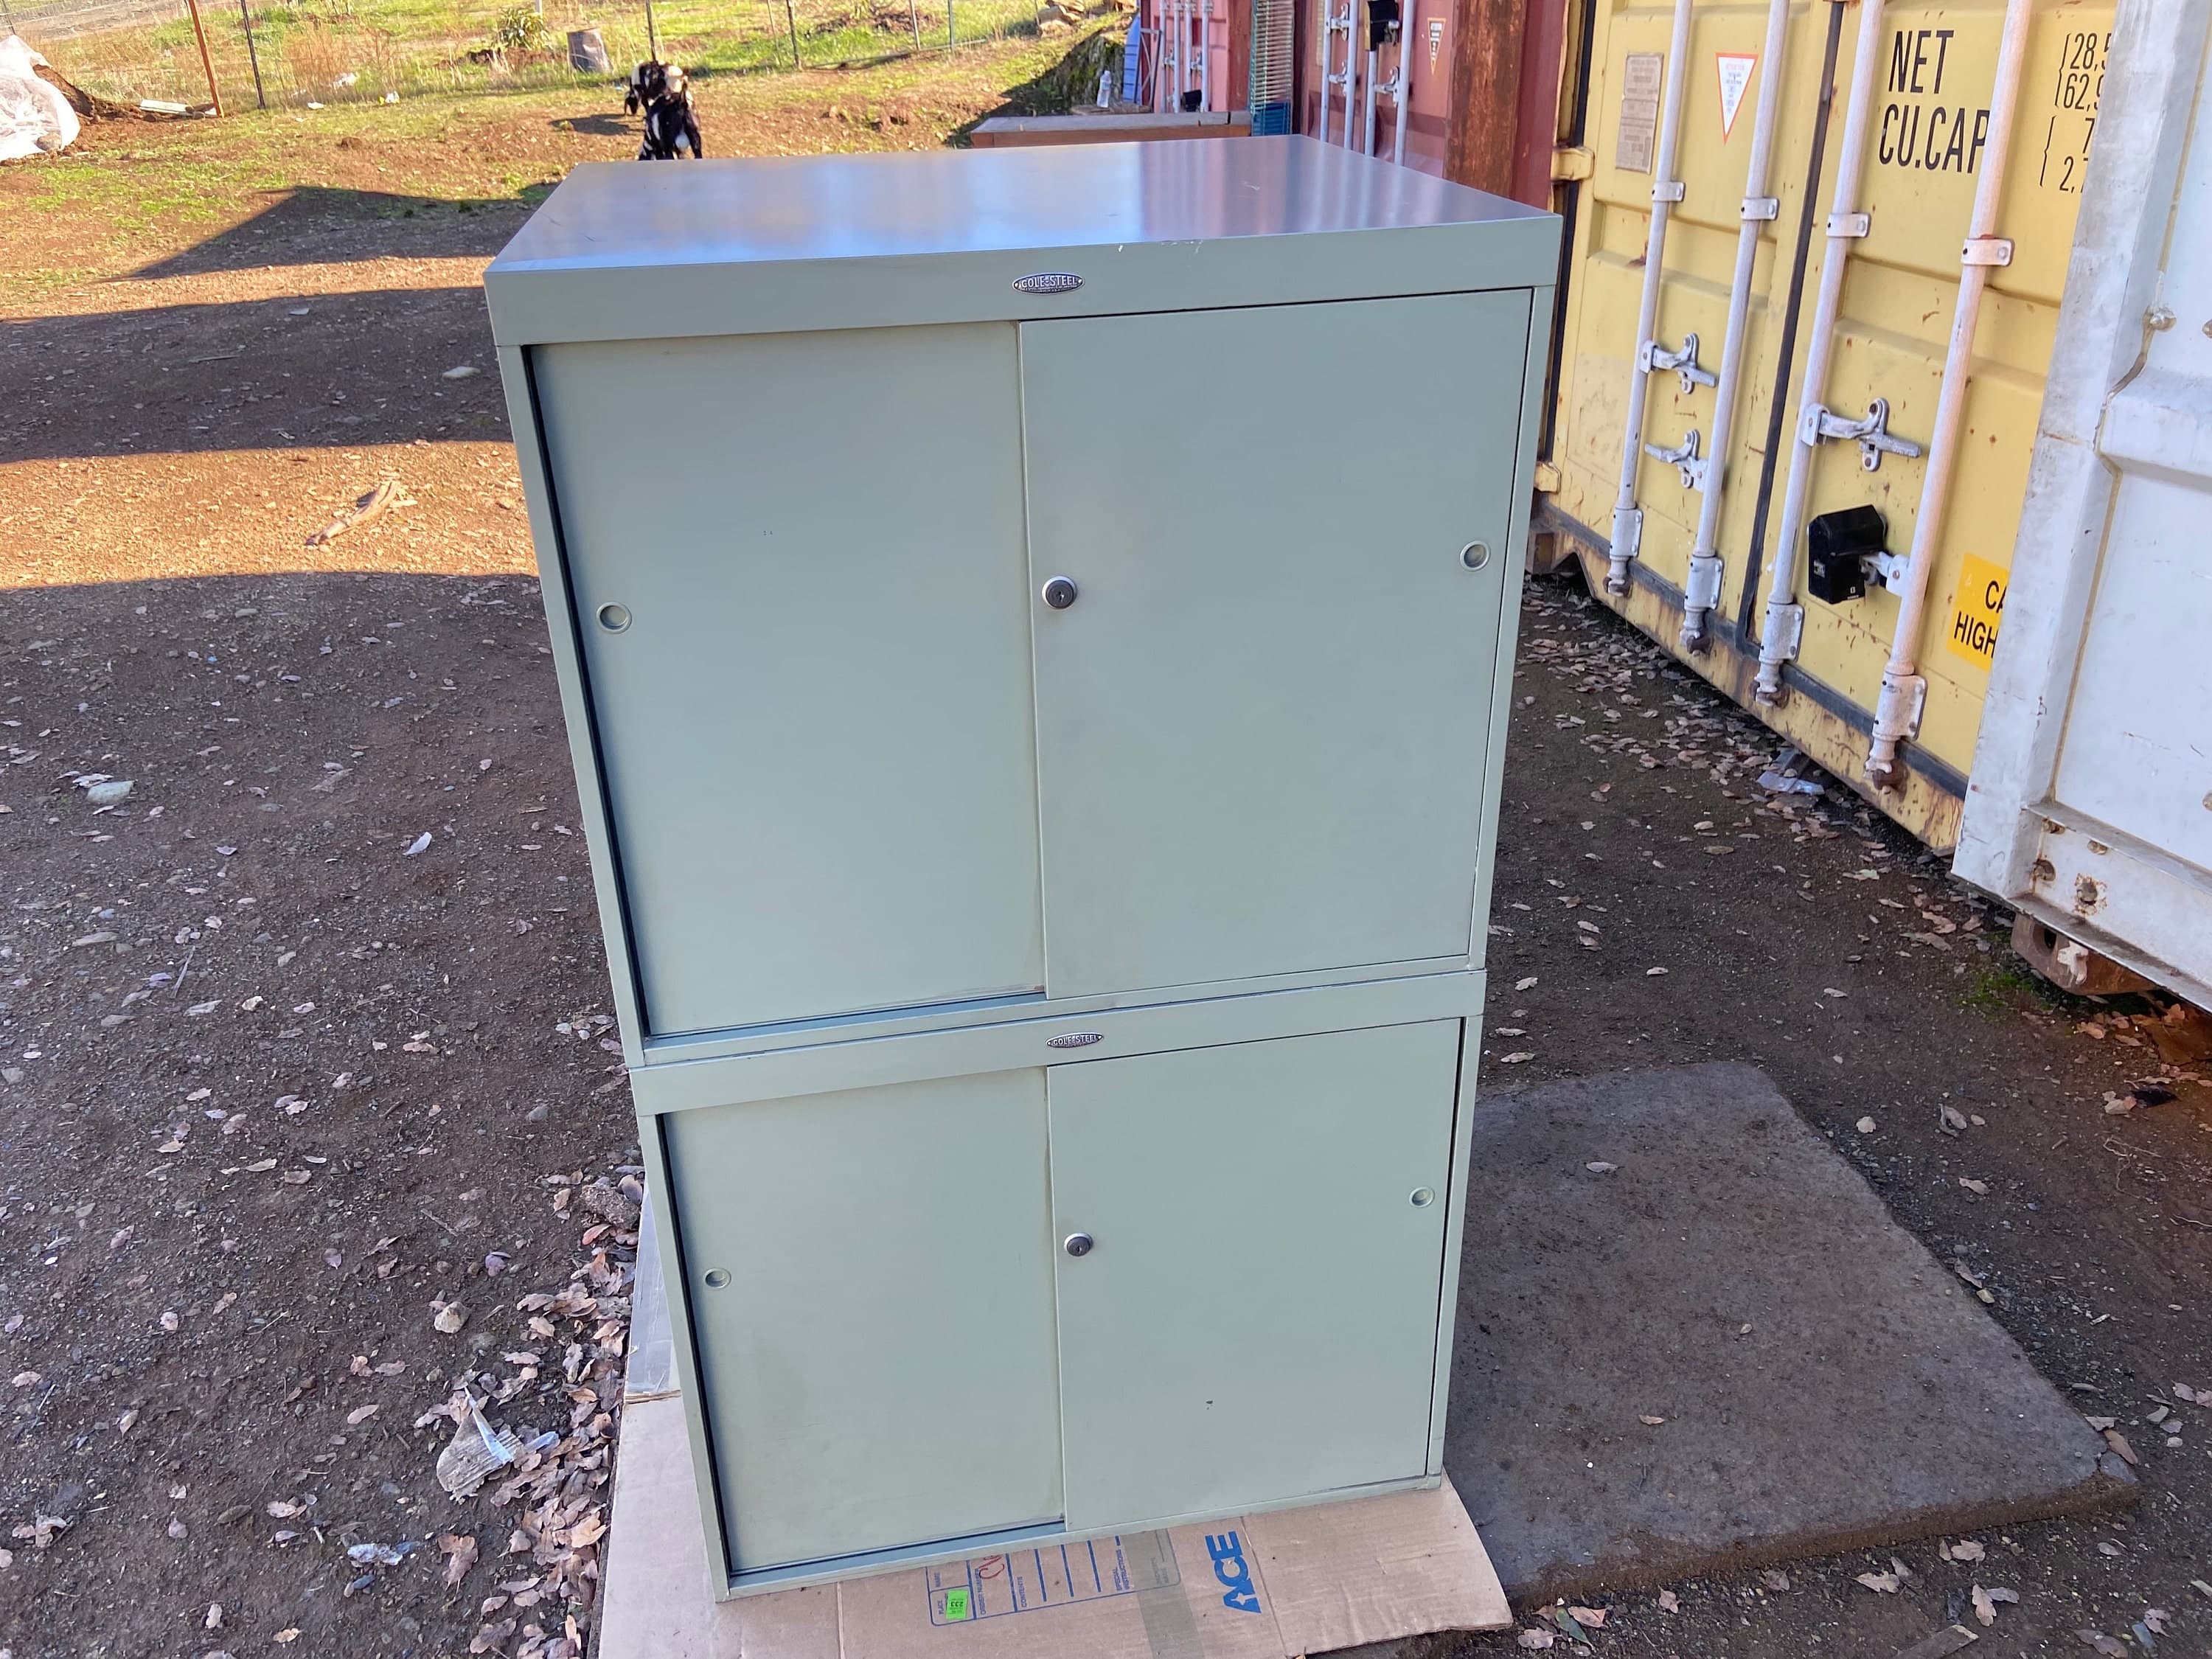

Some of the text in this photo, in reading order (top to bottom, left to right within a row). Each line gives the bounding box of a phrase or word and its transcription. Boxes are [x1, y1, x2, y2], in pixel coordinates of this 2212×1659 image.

[1888, 29, 1954, 94] NET
[1878, 103, 1990, 174] CU.CAP
[1954, 611, 1998, 658] HIGH
[1205, 1531, 1262, 1614] ACE
